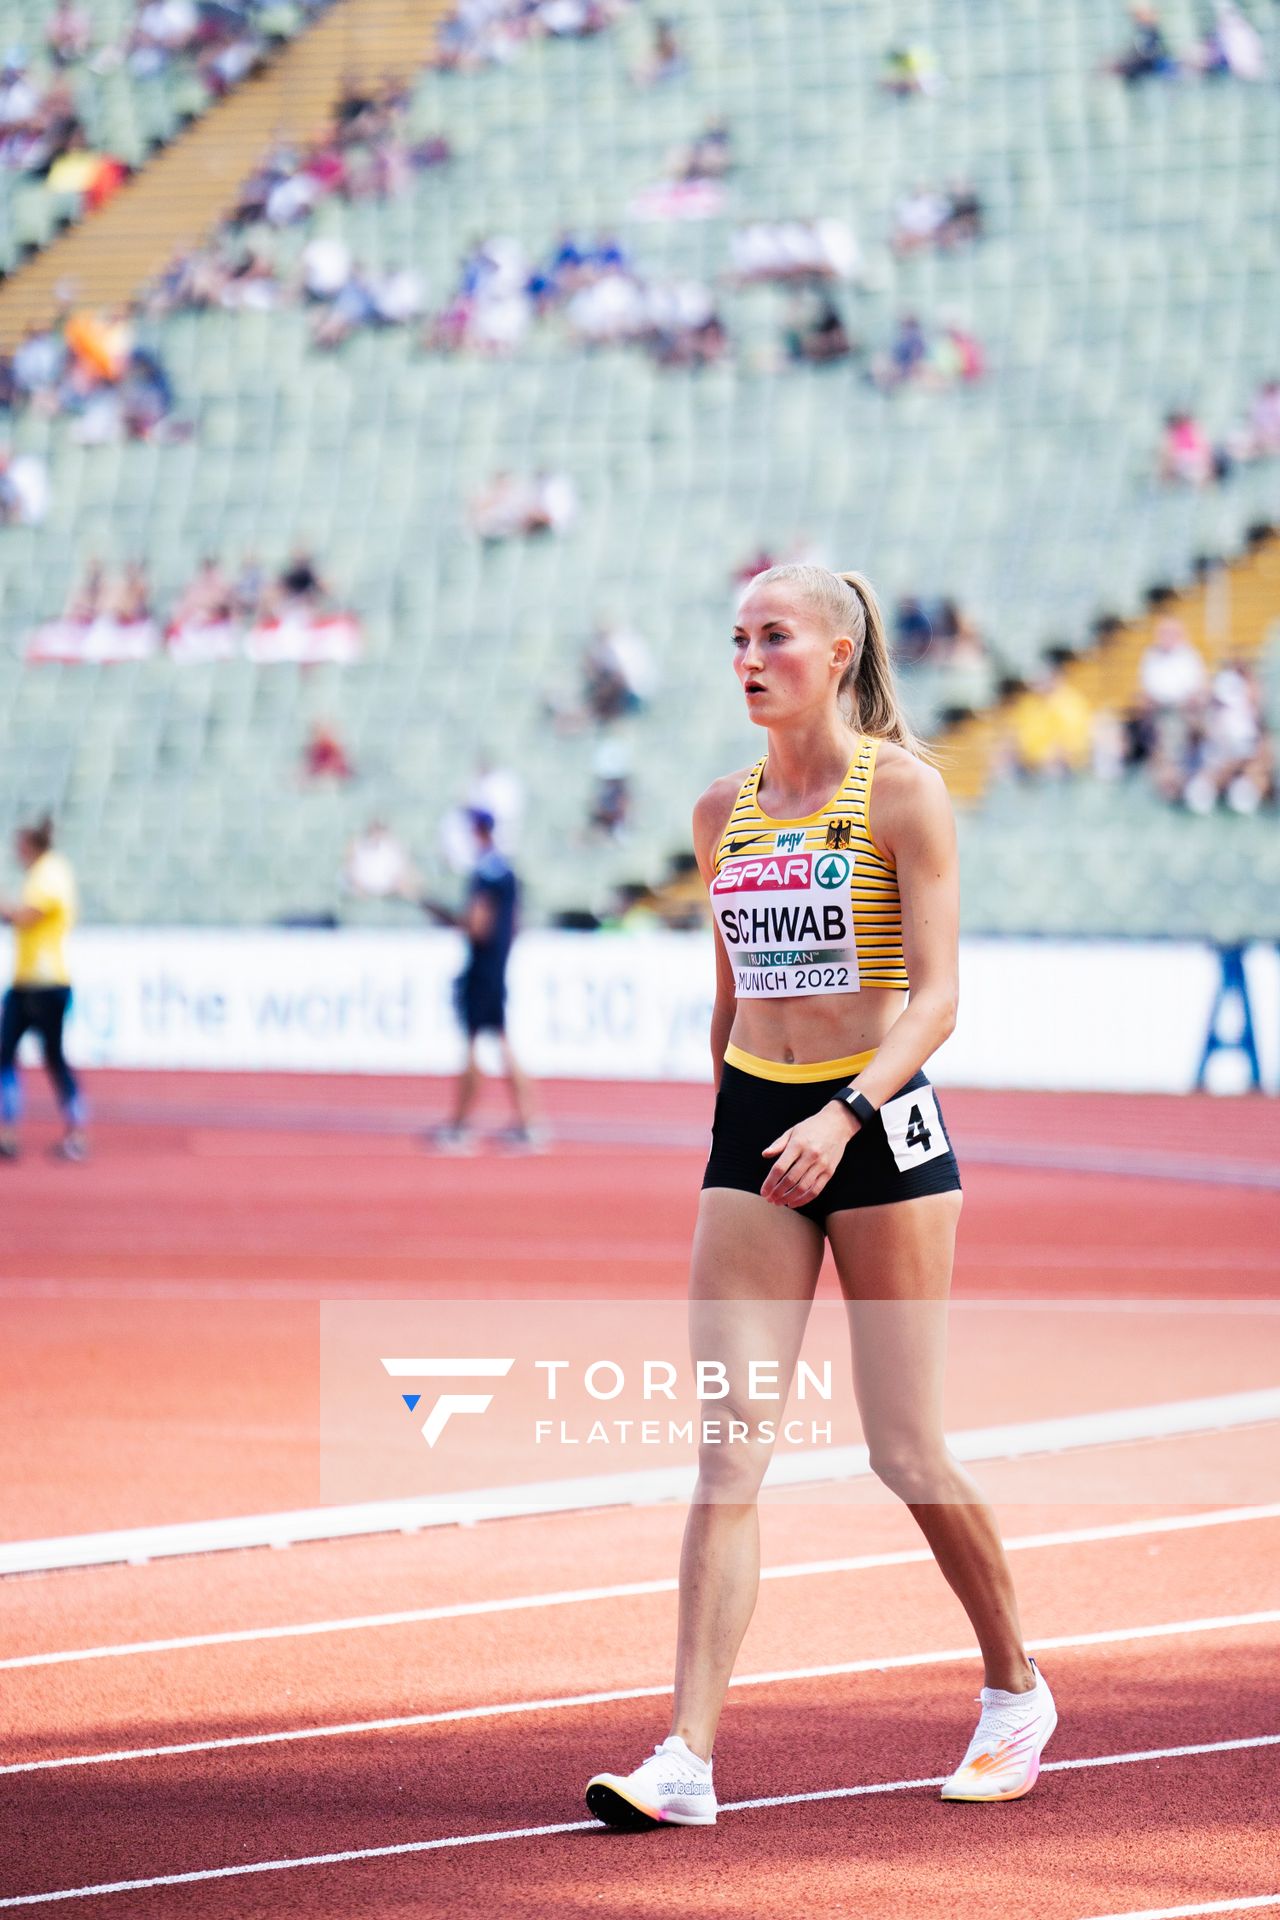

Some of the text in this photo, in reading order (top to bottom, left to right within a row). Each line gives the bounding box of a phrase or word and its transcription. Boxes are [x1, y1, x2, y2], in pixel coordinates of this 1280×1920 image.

[716, 858, 809, 890] SPAR
[720, 905, 847, 944] SCHWAB
[751, 953, 772, 966] RUN
[738, 967, 849, 992] MUNICH 2022
[139, 965, 230, 1037] the
[254, 968, 415, 1042] world
[905, 1103, 932, 1153] 4
[656, 1781, 677, 1795] new
